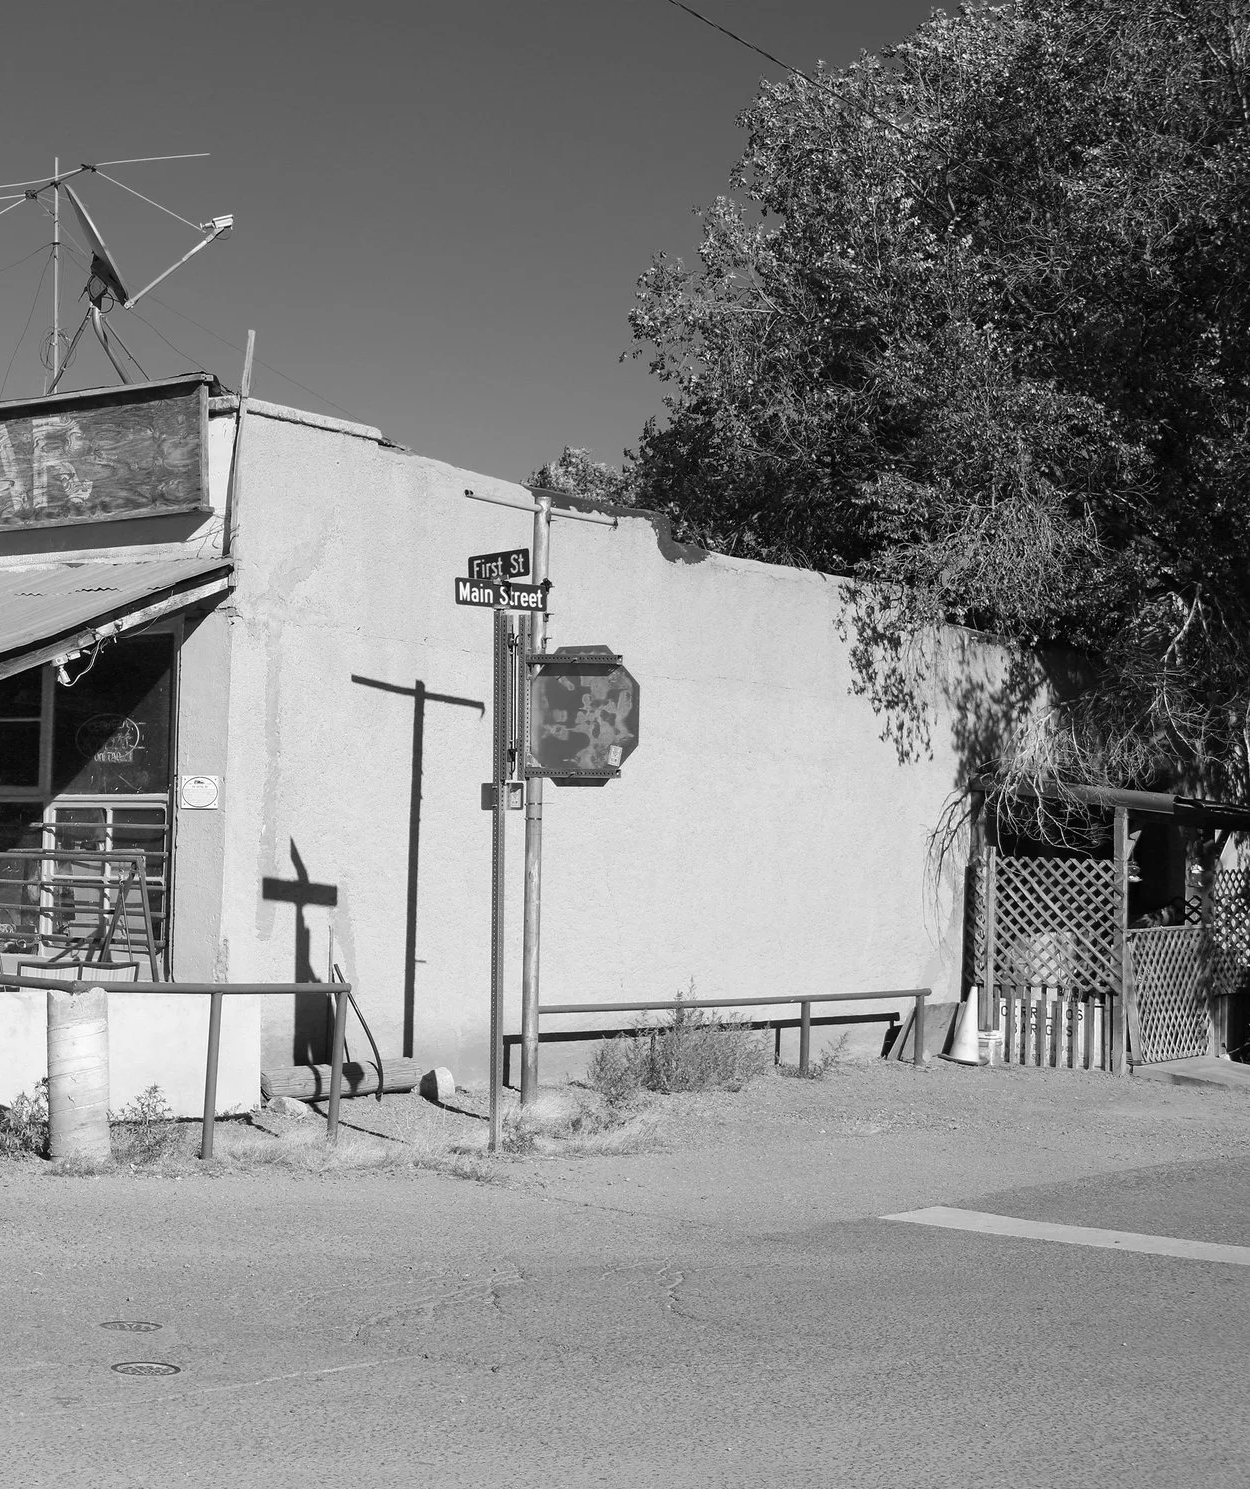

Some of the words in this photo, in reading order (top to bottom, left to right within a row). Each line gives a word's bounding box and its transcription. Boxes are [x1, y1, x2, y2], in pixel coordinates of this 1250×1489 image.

[473, 557, 503, 579] First
[510, 553, 525, 574] St
[459, 581, 494, 604] Main
[499, 586, 543, 608] Street
[1001, 1005, 1084, 1021] CRRLOS
